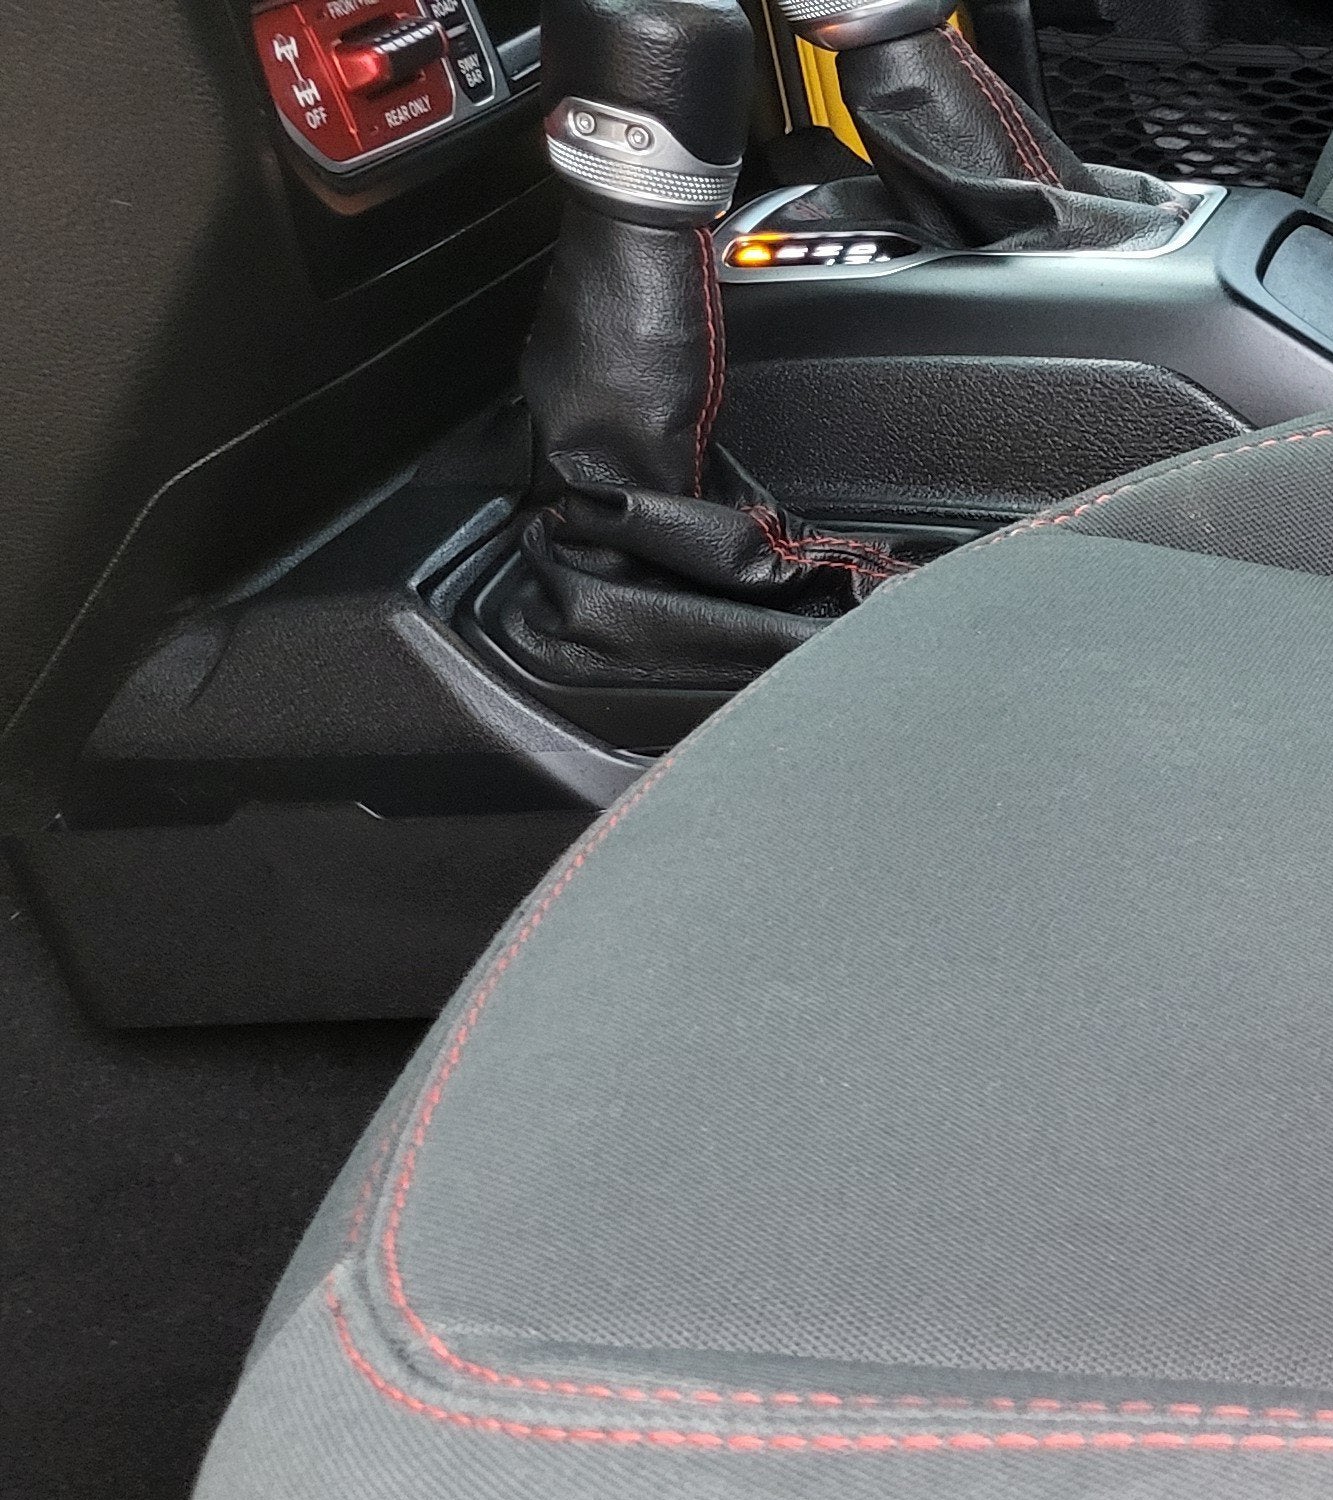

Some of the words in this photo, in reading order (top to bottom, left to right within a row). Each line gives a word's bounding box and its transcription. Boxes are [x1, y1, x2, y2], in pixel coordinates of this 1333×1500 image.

[457, 53, 480, 75] SWAY
[465, 69, 485, 88] BAR
[304, 106, 328, 130] OFF
[384, 105, 412, 129] REAR
[408, 94, 432, 118] ONLY
